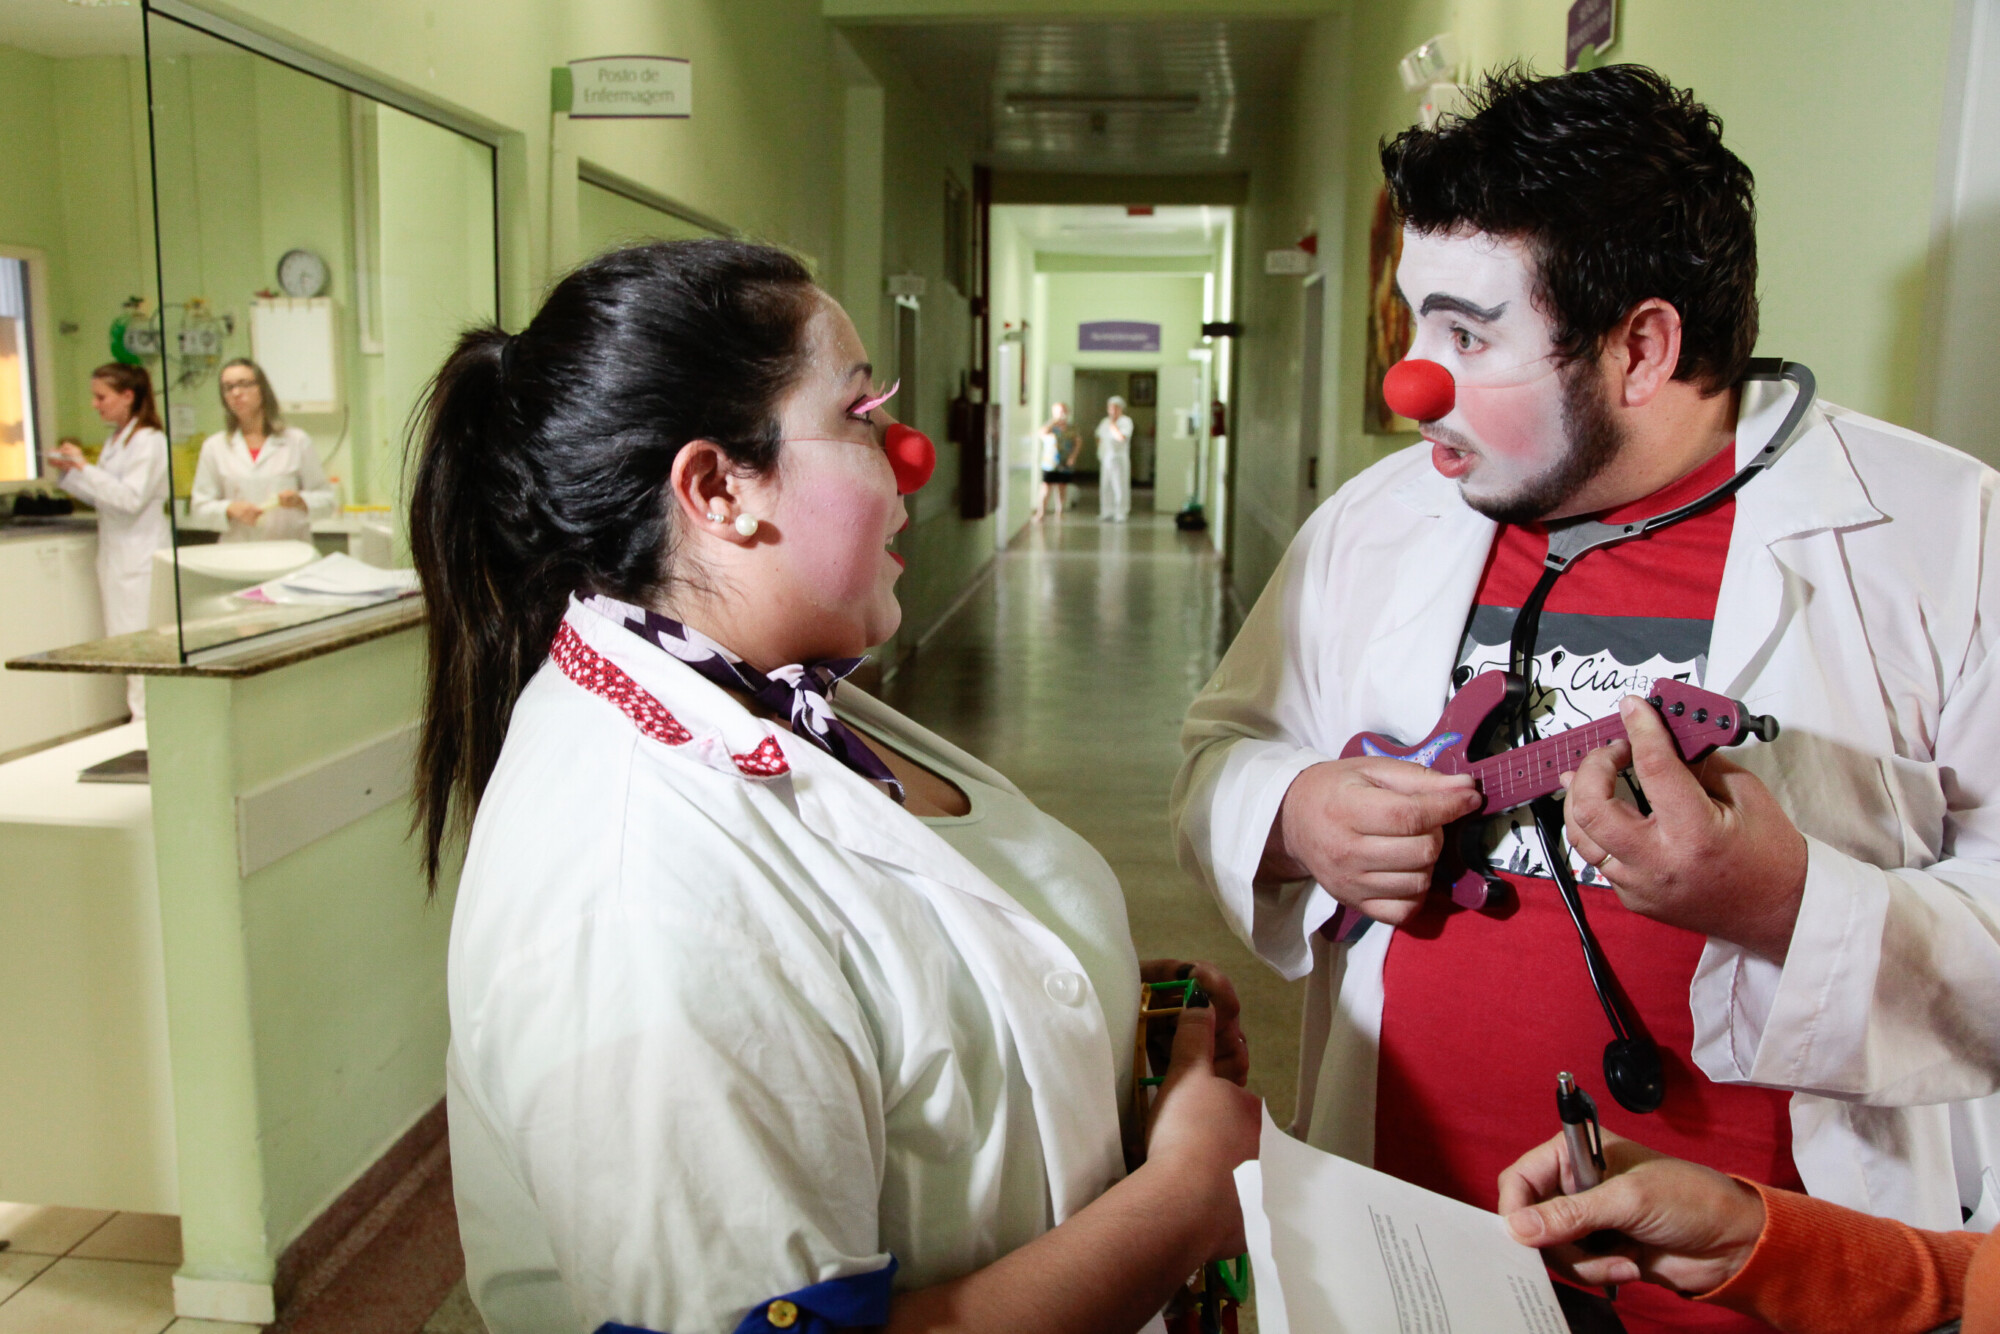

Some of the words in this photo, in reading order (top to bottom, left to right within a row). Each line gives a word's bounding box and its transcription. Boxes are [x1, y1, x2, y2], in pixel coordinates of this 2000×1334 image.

[598, 67, 637, 82] Posto
[641, 67, 659, 82] de
[584, 87, 675, 106] Enfermagem
